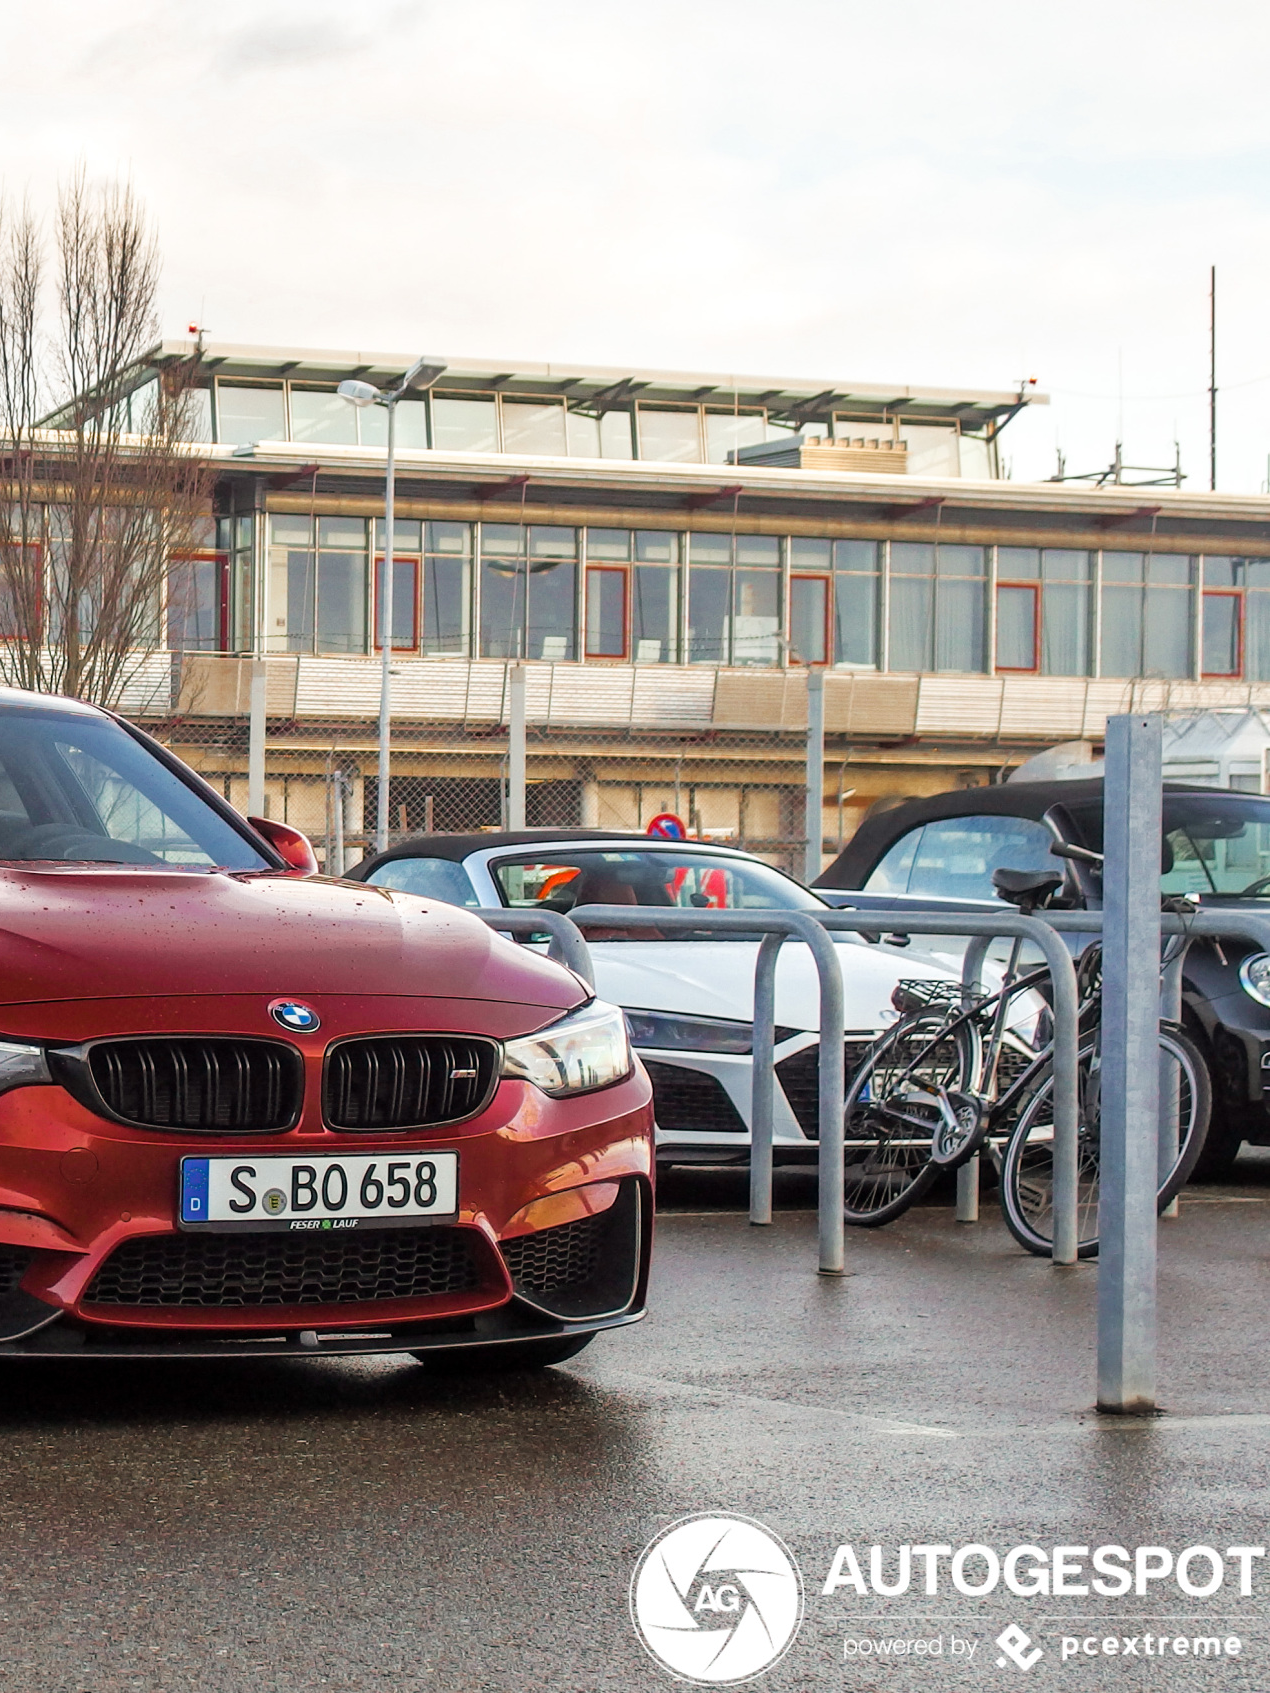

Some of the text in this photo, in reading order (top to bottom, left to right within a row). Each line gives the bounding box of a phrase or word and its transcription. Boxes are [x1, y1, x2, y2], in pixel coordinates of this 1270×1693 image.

[229, 1161, 437, 1213] S BO 658
[190, 1198, 201, 1211] D
[290, 1218, 359, 1229] FESER LAUF
